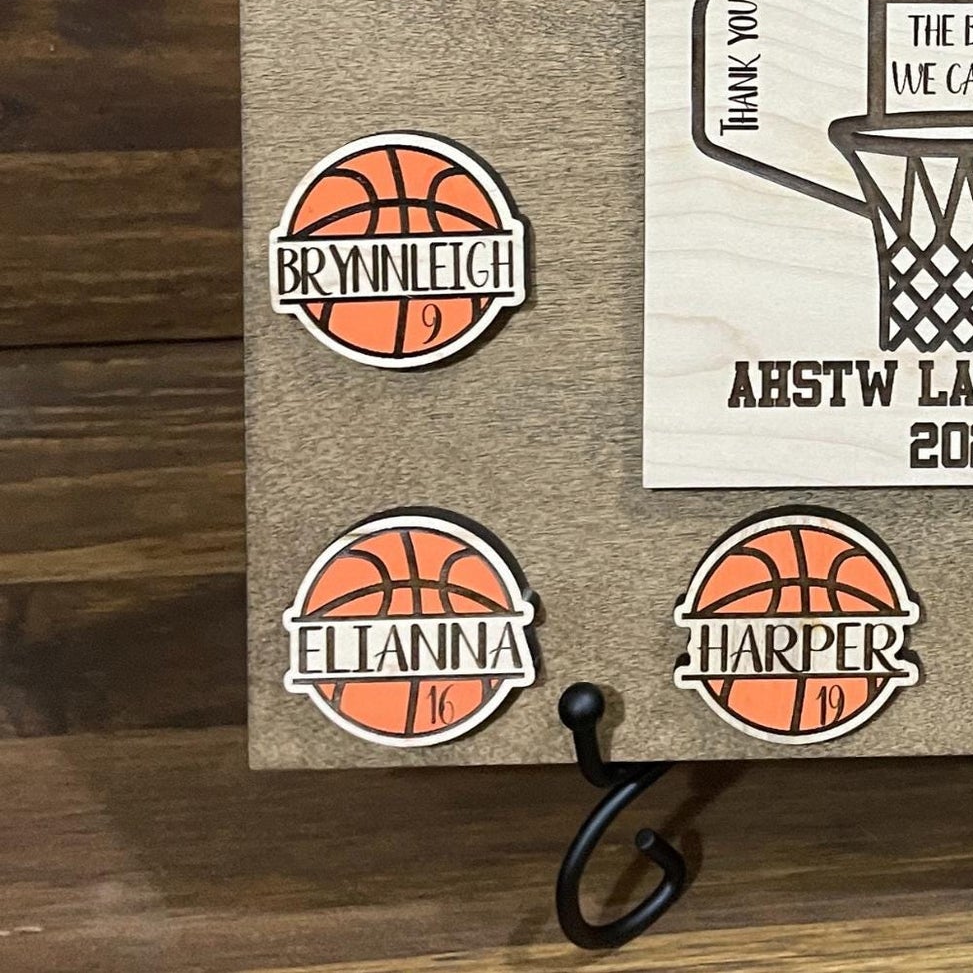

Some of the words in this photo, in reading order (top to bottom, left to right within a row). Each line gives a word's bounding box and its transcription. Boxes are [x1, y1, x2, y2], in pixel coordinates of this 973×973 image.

[908, 14, 956, 48] THE
[719, 53, 762, 136] THANK
[891, 61, 937, 96] WE
[277, 240, 514, 296] BRYNNLEIGH
[421, 303, 442, 345] 9
[727, 360, 899, 408] AHSTW
[298, 621, 524, 674] ELIANNA
[695, 623, 901, 673] HARPER
[425, 686, 456, 724] 16
[816, 684, 847, 726] 19
